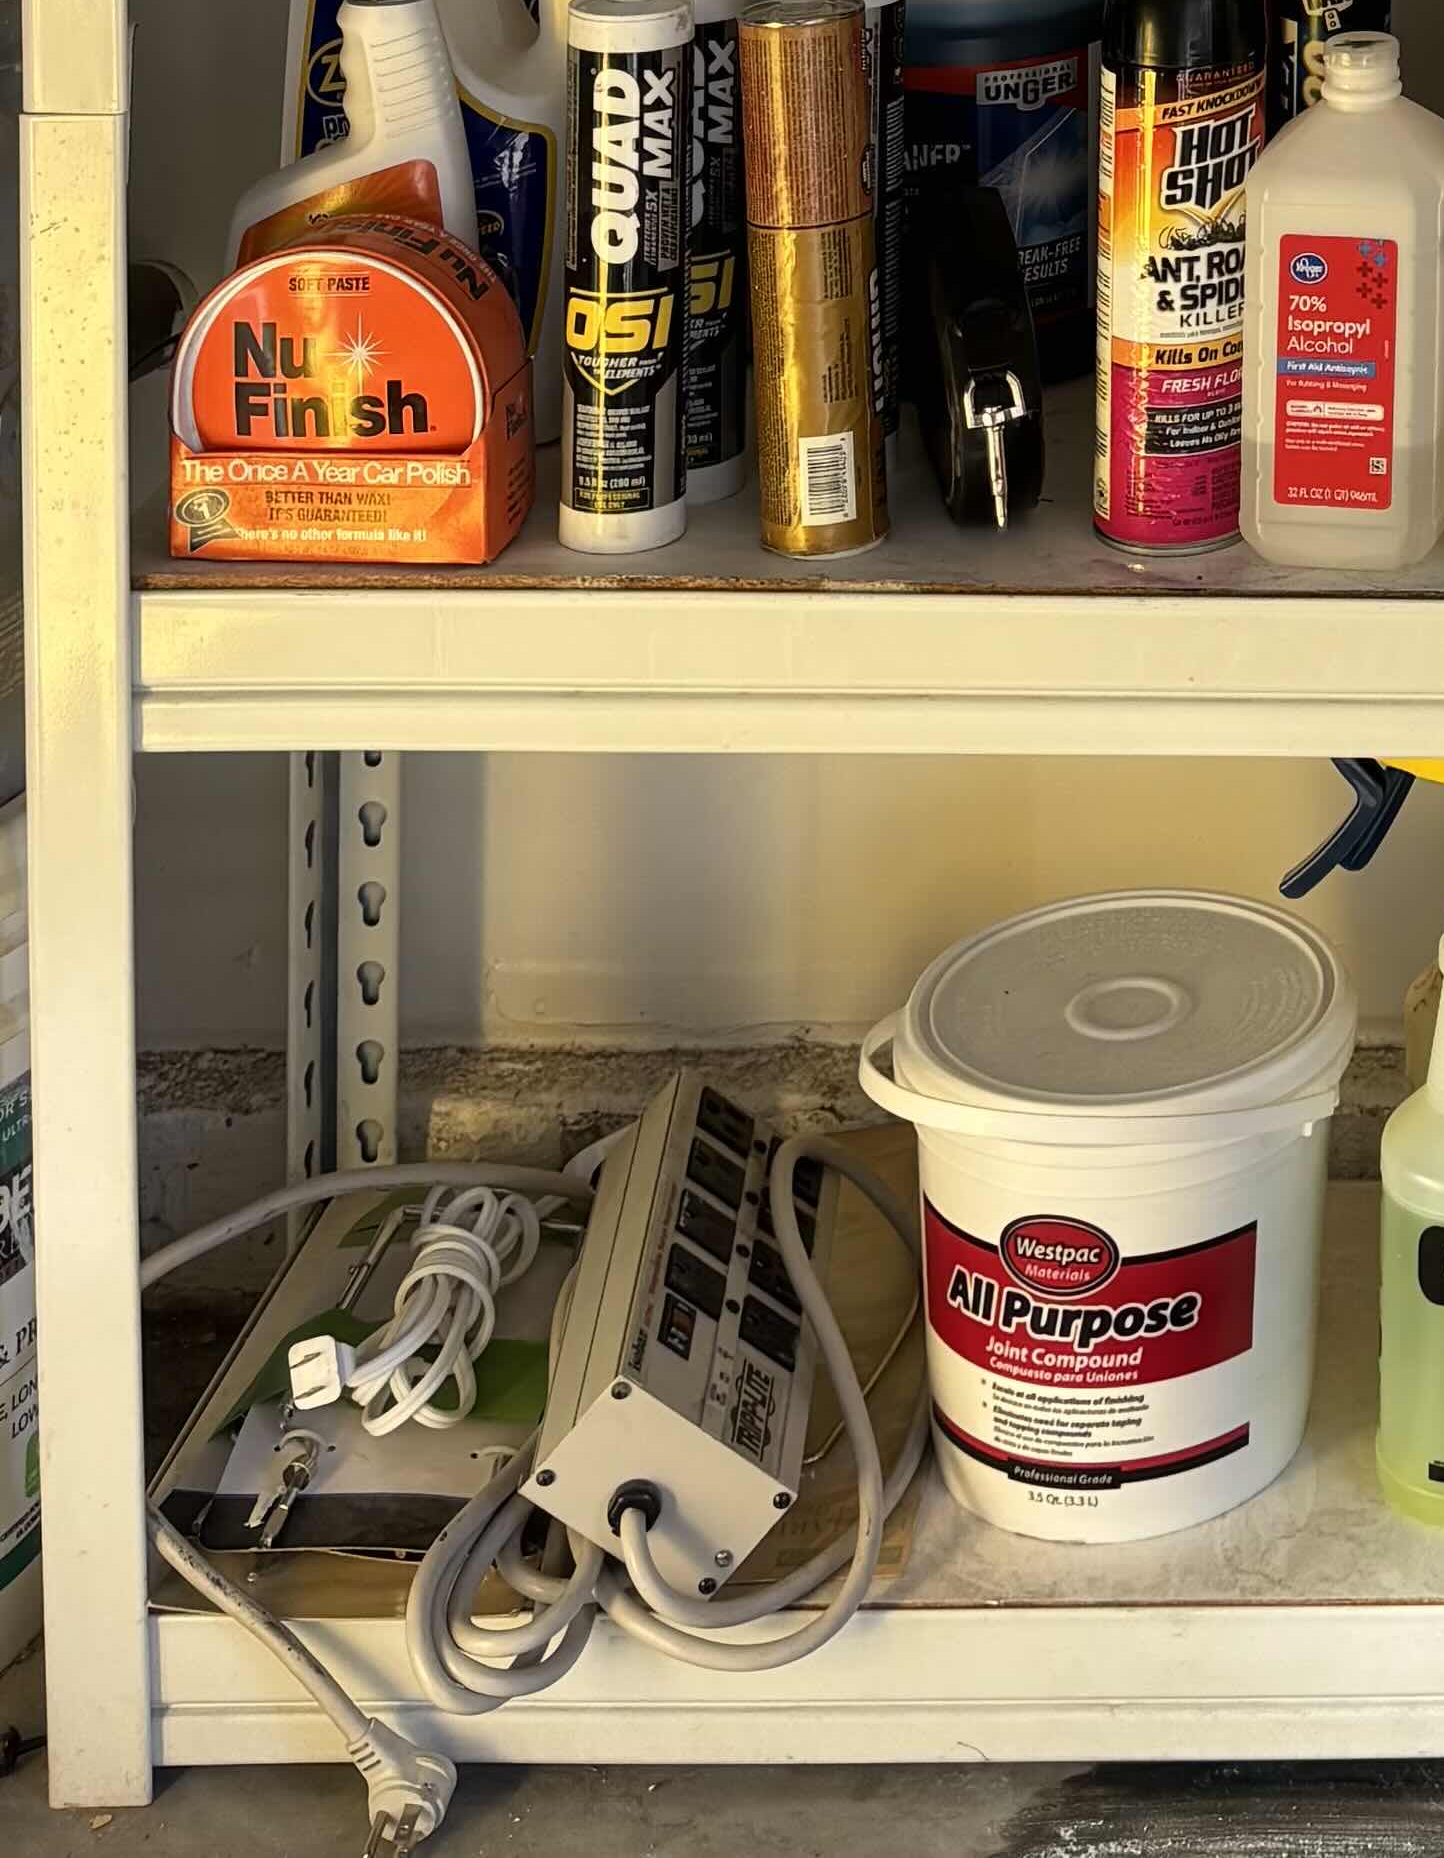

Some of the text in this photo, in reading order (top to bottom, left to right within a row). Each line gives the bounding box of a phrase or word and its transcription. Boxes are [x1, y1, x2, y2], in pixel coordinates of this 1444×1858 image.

[707, 39, 736, 145] MAX
[984, 73, 1075, 105] UNGER
[642, 68, 675, 179] MAX
[1161, 103, 1195, 120] FAST
[1178, 106, 1256, 168] HOT
[590, 68, 641, 265] QUAD
[288, 276, 371, 291] SOFT PASTE
[1156, 289, 1176, 312] &
[1288, 294, 1328, 313] 70%
[566, 292, 675, 353] OSI
[1287, 314, 1371, 339] Isopropyl
[233, 320, 318, 380] Nu
[1155, 345, 1219, 365] Kills On
[1286, 334, 1354, 354] Alcohol
[1160, 375, 1213, 394] FRESH
[234, 379, 429, 439] Finish
[183, 459, 472, 486] The Once A Year Car Polish
[265, 490, 392, 506] BETTER THAN WAX!
[296, 507, 388, 523] GUARANTEED!
[281, 528, 407, 542] no other formula like
[1014, 1236, 1102, 1266] Westpac
[1023, 1263, 1092, 1283] Materials
[949, 1268, 1199, 1349] All Purpose
[985, 1335, 1143, 1372] Joint Compound
[989, 1357, 1139, 1385] Compuesto para Uniones
[1013, 1465, 1113, 1485] Professional Grade
[1027, 1489, 1044, 1504] 3.5
